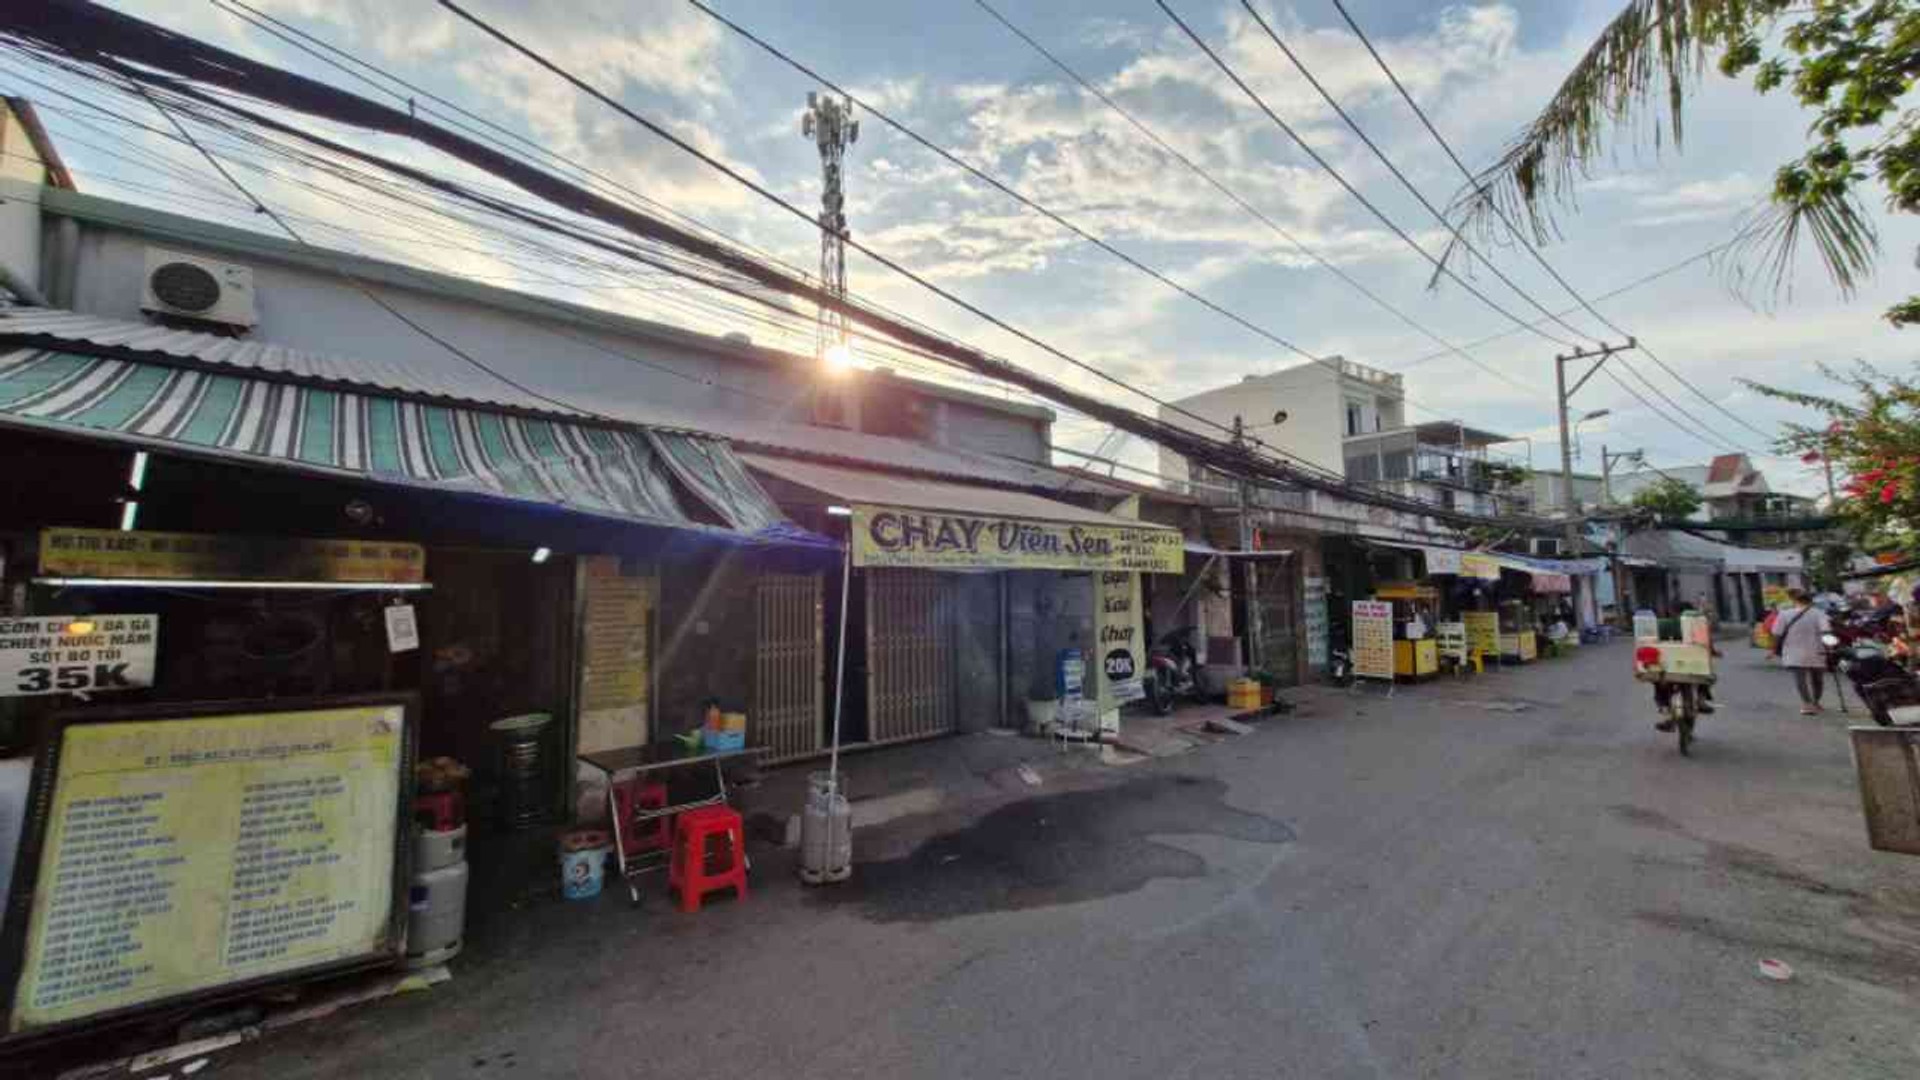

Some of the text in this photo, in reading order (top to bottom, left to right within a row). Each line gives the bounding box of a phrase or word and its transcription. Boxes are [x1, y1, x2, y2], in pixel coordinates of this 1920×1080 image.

[869, 512, 982, 554] CHAY
[1065, 526, 1113, 557] Sen
[17, 662, 130, 692] 35K
[1105, 657, 1133, 673] 20K
